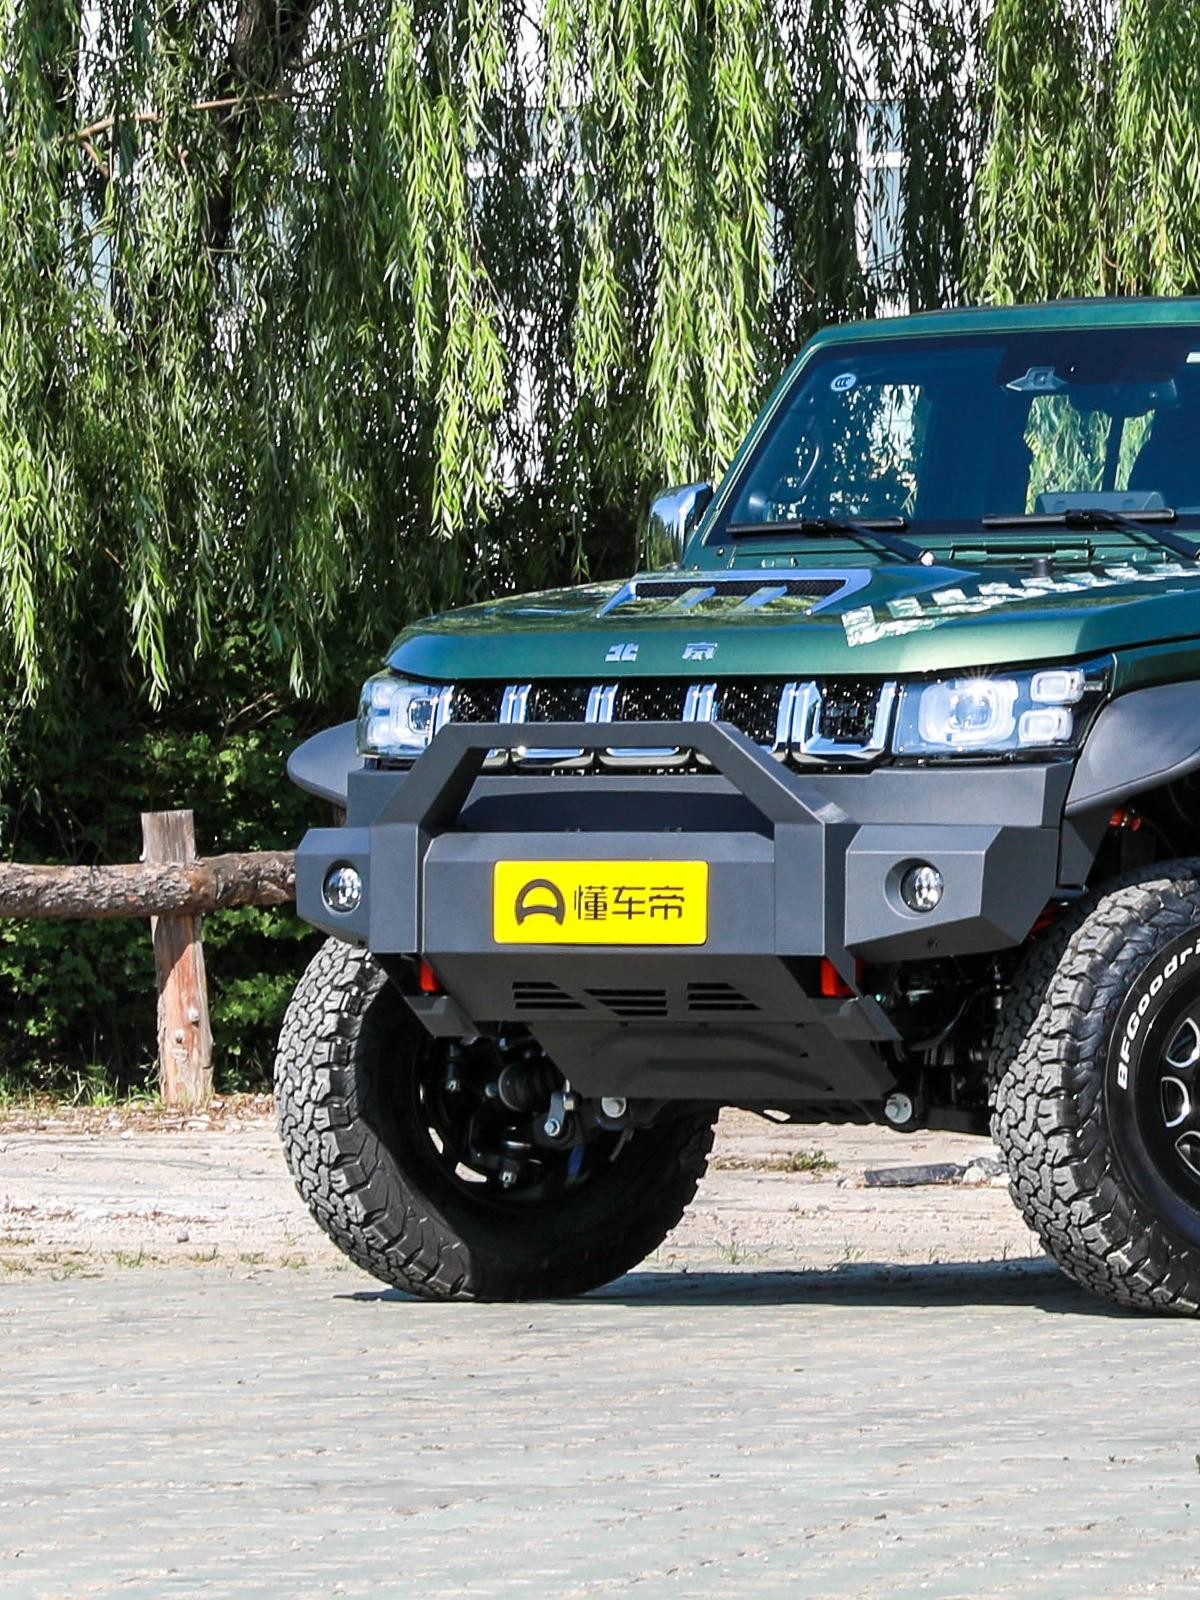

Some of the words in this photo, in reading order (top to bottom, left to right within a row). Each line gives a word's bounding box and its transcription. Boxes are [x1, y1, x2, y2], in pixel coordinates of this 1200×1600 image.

[604, 641, 718, 662] 北京
[574, 885, 685, 920] 懂车帝
